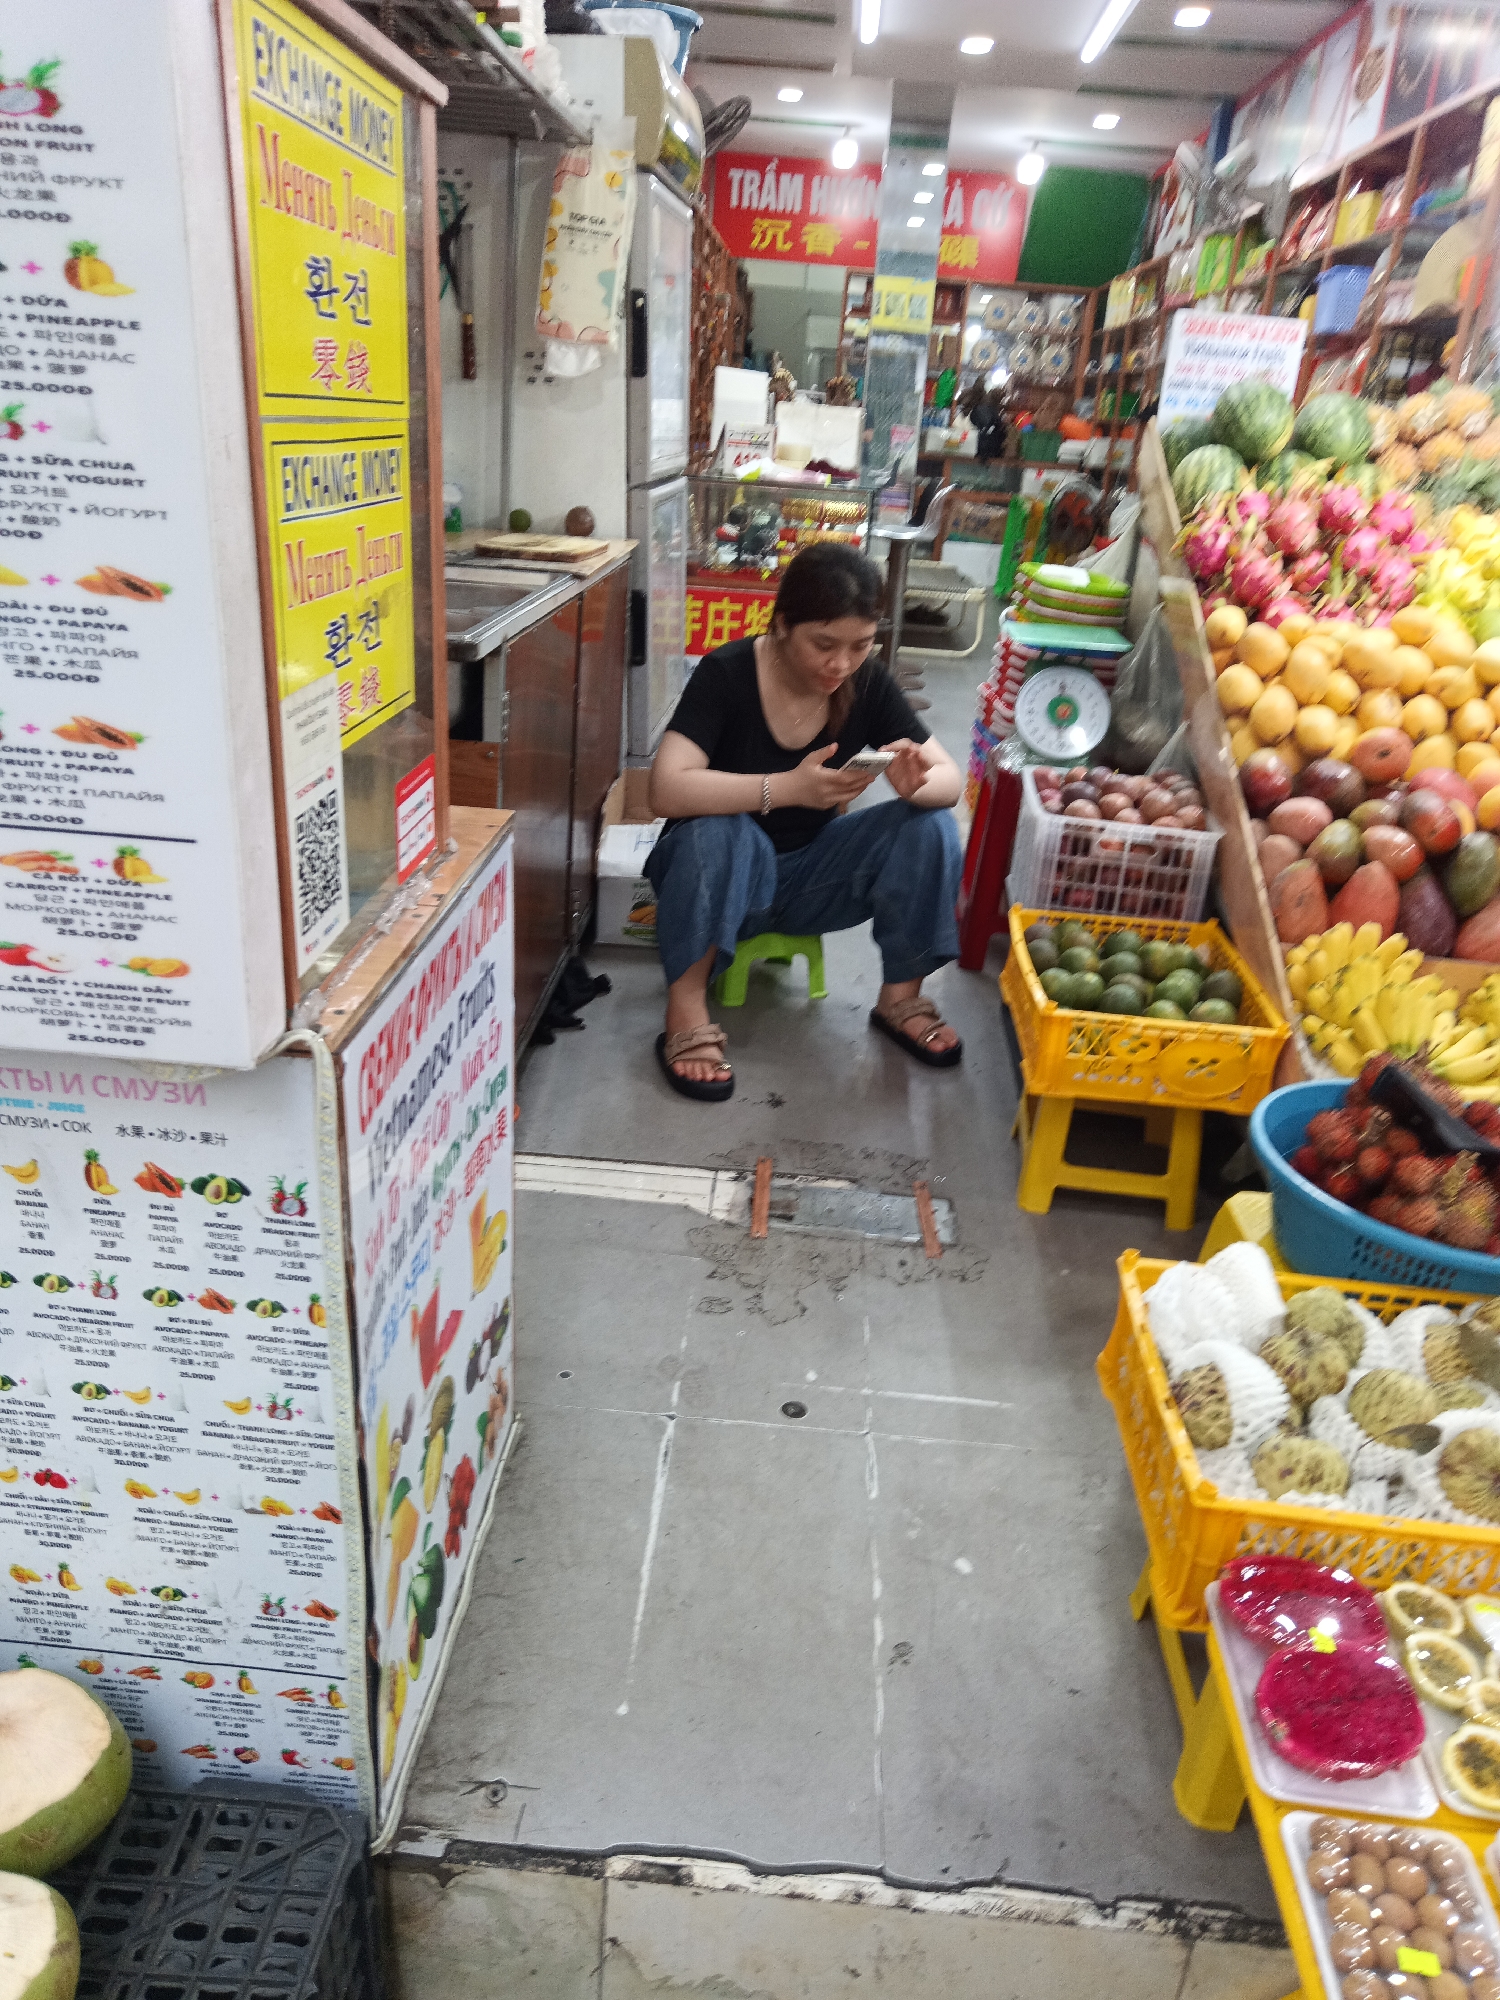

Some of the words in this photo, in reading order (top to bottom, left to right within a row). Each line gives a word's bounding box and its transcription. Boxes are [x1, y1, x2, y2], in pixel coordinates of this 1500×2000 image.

[253, 16, 344, 140] EXCHANGE
[348, 86, 396, 168] MONEY
[24, 122, 84, 135] LONG
[34, 139, 95, 152] FRUIT
[256, 122, 337, 232] Менять
[341, 168, 397, 257] Деньги
[810, 174, 879, 223] HƯƠN
[942, 178, 964, 229] À
[749, 218, 843, 257] 沉香
[304, 254, 373, 327] 환전
[24, 313, 142, 331] PINEAPPLE
[43, 348, 137, 365] АНАНАС
[0, 380, 94, 396] 25.000Đ
[31, 453, 74, 467] SỮA
[78, 459, 136, 472] CHUA
[63, 473, 147, 488] YOGURT
[281, 452, 359, 514] EXCHANGE
[360, 447, 403, 499] MONEY
[84, 502, 168, 521] ЙОГУРТ
[284, 538, 353, 610] Менять
[355, 524, 404, 599] Деньги
[57, 618, 129, 632] PAPAYA
[324, 600, 383, 669] 환전
[54, 644, 140, 659] ПАПАЙЯ
[13, 668, 101, 684] 25.000Đ
[65, 763, 135, 775] PAPAYA
[0, 781, 65, 795] ФРУКТ
[83, 787, 166, 802] ПАПАЙЯ
[1, 811, 85, 825] 25.000Đ
[4, 881, 69, 893] CARROT
[85, 887, 174, 901] PINEAPPLE
[5, 902, 92, 917] МОРКОВЬ
[108, 911, 179, 924] АНАНАС
[56, 927, 138, 942] 25.000Đ
[0, 984, 59, 995] CARROT
[75, 990, 143, 1002] PASSION
[147, 996, 191, 1007] FRUIT
[0, 1004, 85, 1018] МОРКОВЬ
[101, 1013, 192, 1028] МАРАКУЙЯ
[67, 1033, 146, 1047] 25.000Đ
[60, 1071, 85, 1095] И
[91, 1074, 207, 1107] СМУЗИ
[368, 1020, 454, 1202] Vietnamese
[456, 960, 496, 1050] Fruits
[0, 1113, 51, 1130] СМУЗИ
[60, 1119, 92, 1134] СОК
